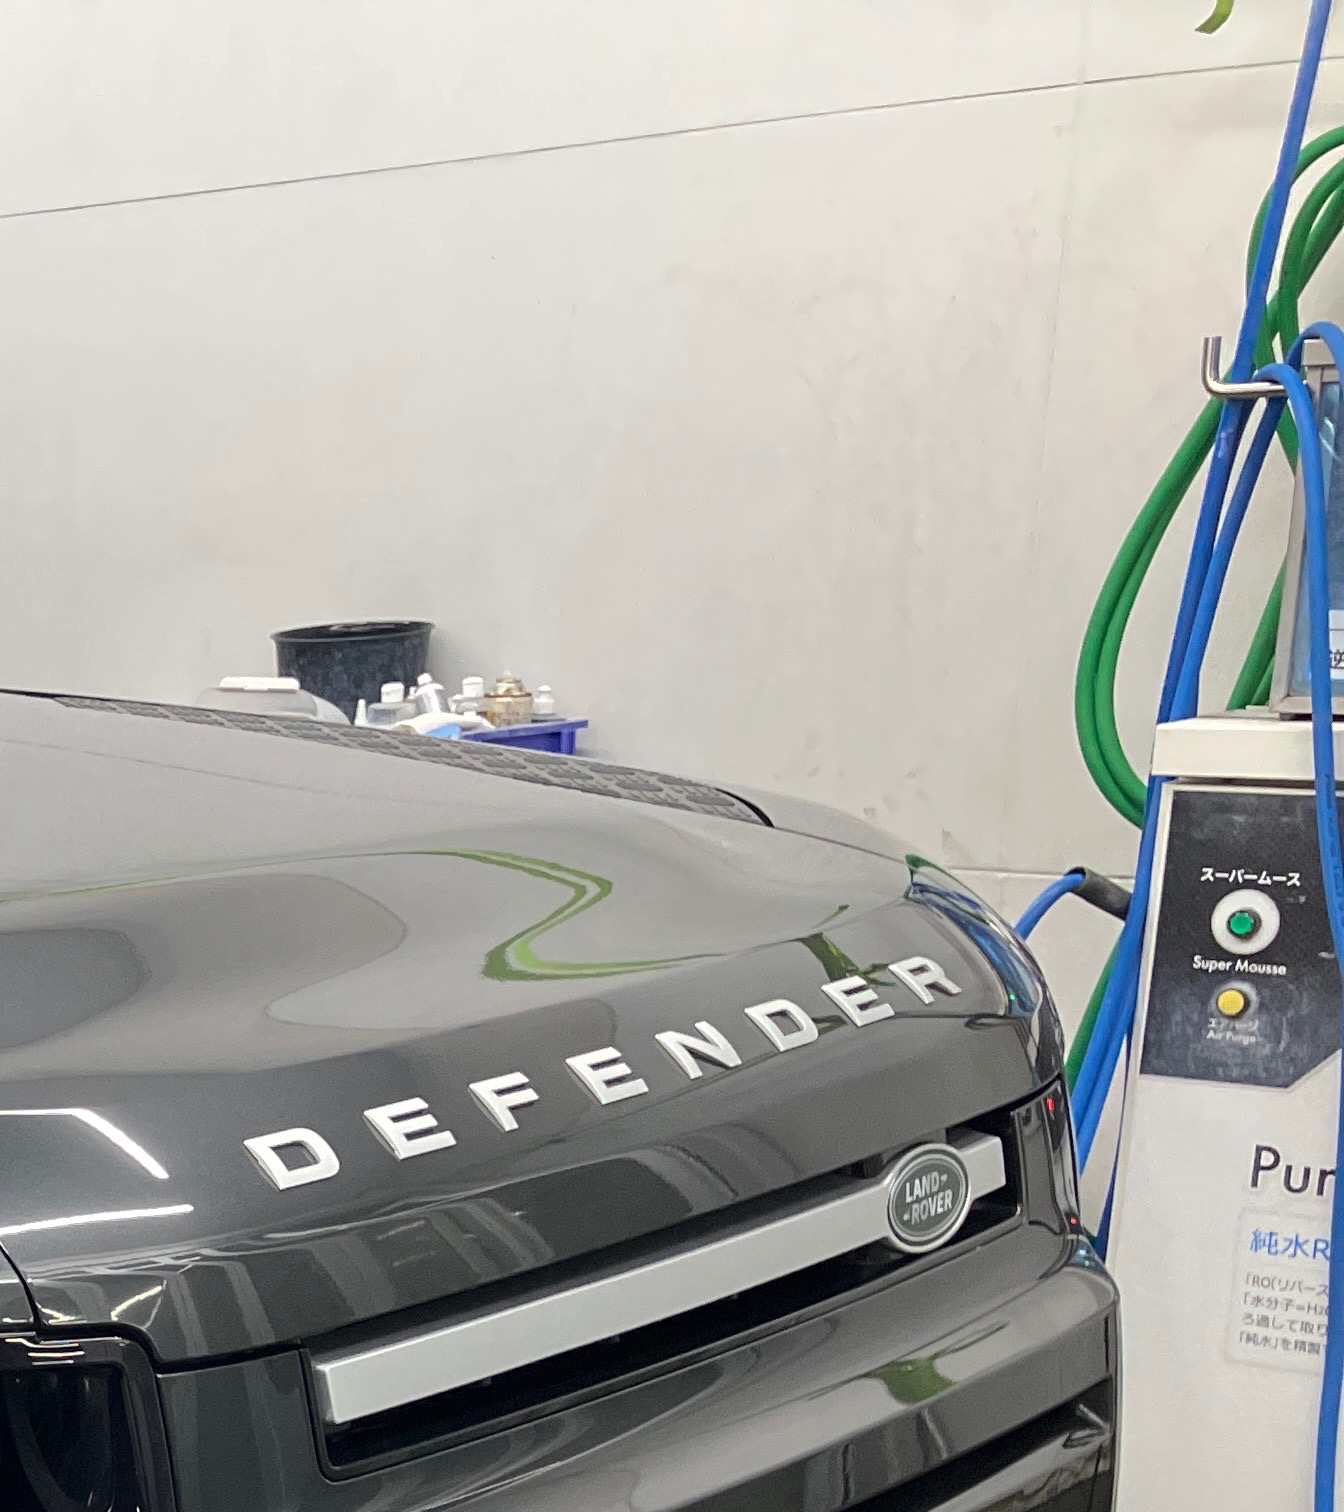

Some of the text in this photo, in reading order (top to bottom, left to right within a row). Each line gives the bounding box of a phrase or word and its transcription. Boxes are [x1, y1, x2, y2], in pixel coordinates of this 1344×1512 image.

[1200, 867, 1301, 887] スーパームース
[1192, 955, 1287, 976] Super Mousse
[243, 954, 962, 1191] DEFENDER
[905, 1171, 940, 1203] LAND
[911, 1189, 953, 1225] ROVER
